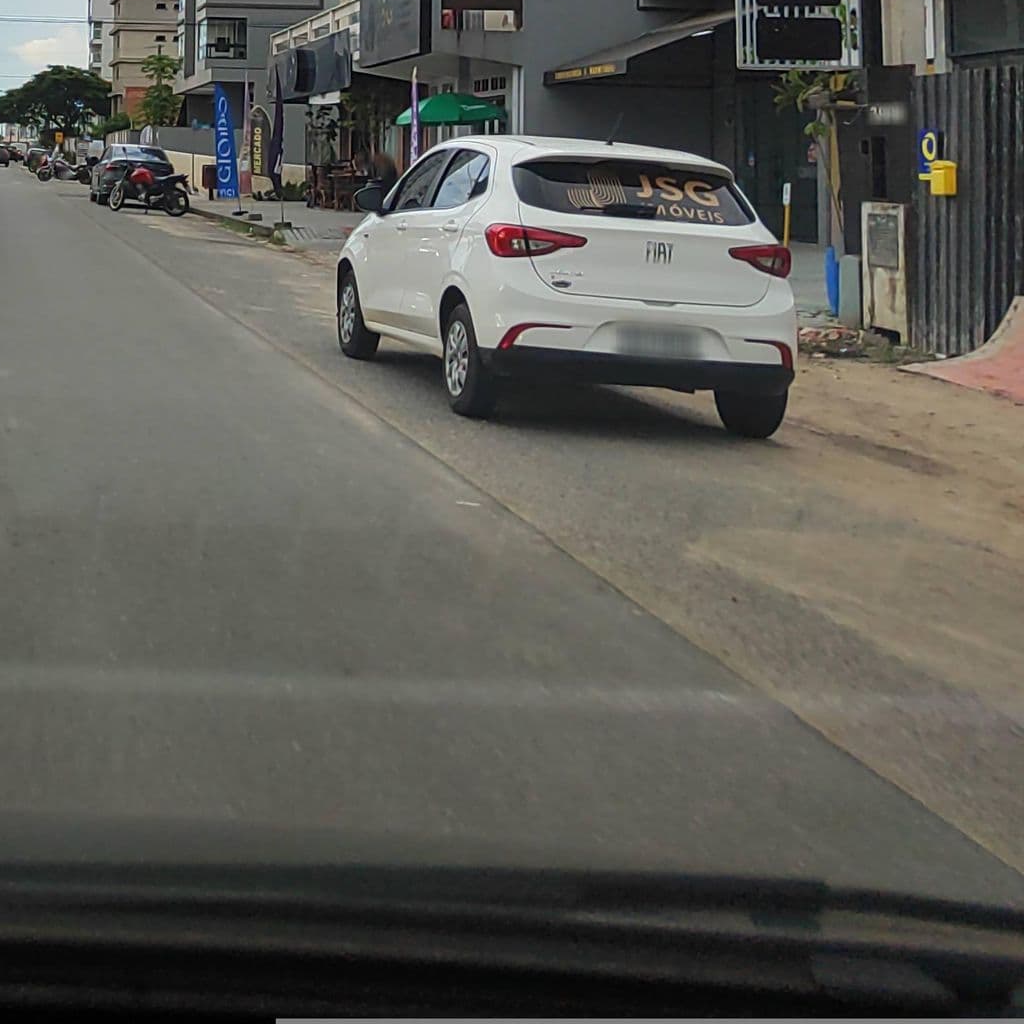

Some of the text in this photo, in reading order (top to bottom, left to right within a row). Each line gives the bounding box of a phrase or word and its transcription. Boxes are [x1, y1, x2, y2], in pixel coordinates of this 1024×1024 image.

[253, 127, 262, 174] MERCADO
[636, 174, 720, 207] JSG
[646, 241, 674, 264] FIAT
